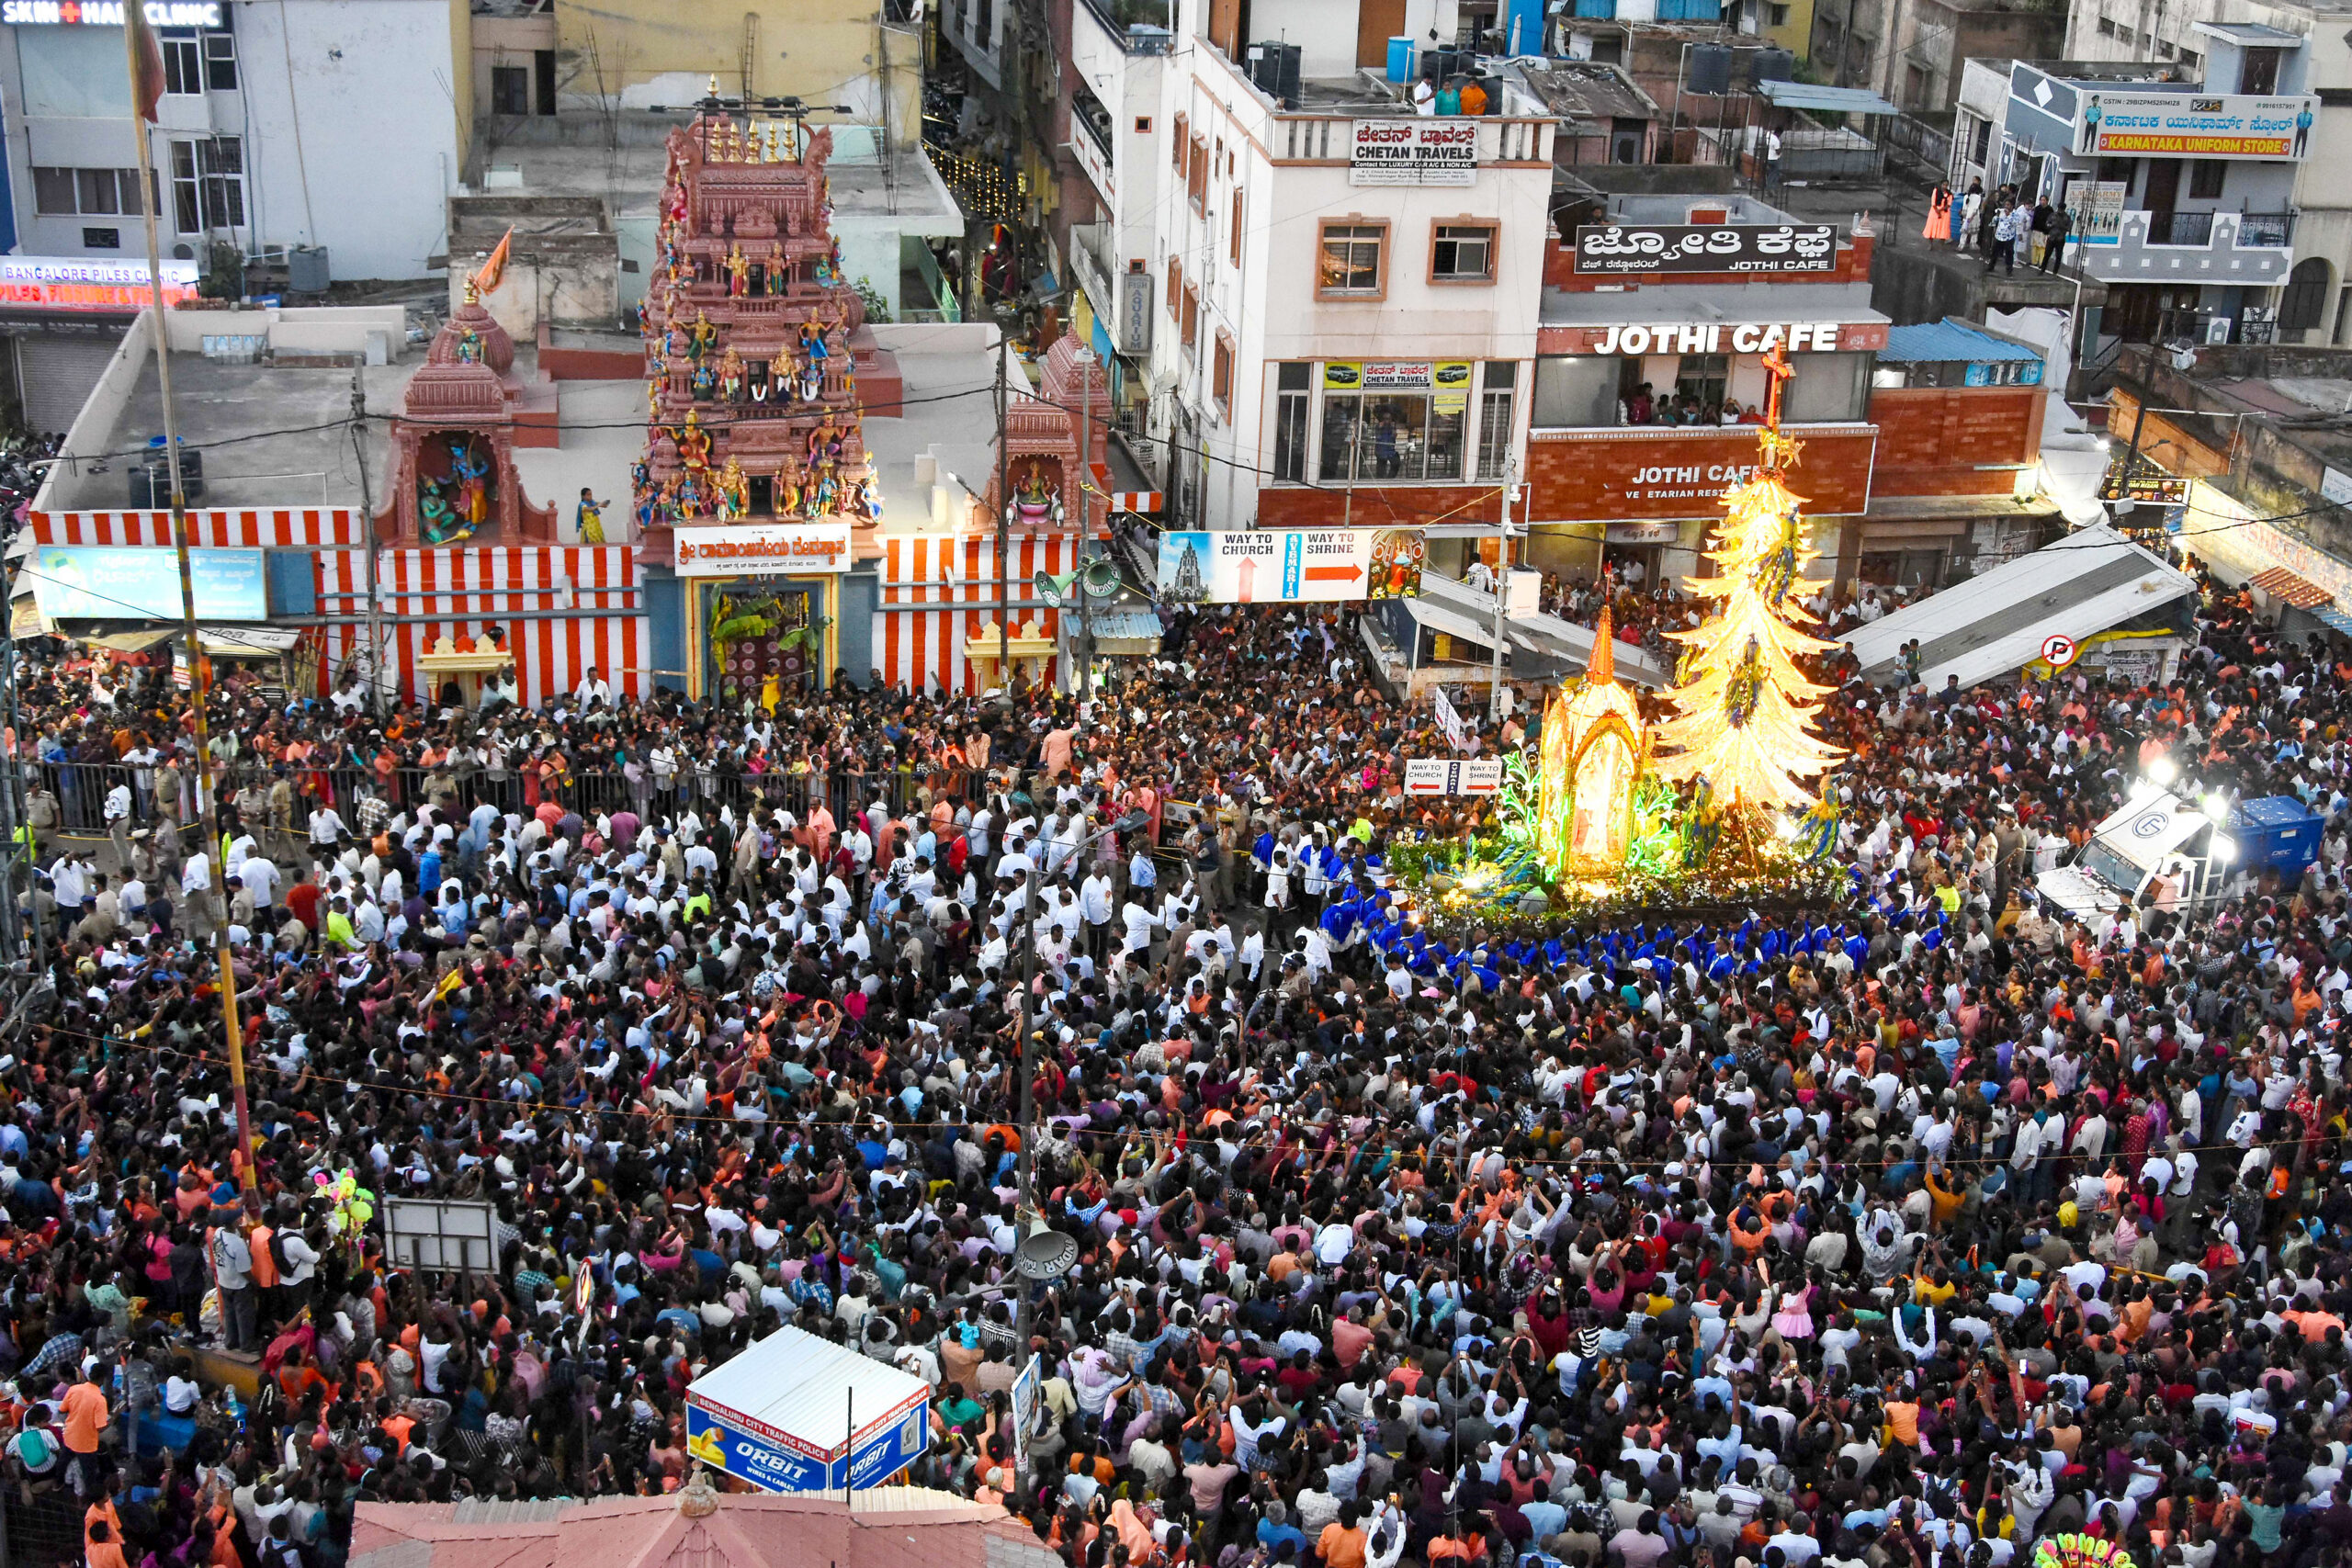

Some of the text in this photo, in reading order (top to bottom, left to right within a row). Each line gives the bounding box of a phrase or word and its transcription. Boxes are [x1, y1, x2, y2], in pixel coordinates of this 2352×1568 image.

[3, 2, 59, 23] SKIN
[142, 4, 220, 25] CLINIC
[1357, 125, 1412, 142] ಚೇತನ್
[1356, 146, 1473, 160] CHETAN TRAVELS
[2108, 136, 2282, 153] KARNATAKA UNIFORM STORE
[1584, 227, 1742, 260] ಜ್ಯೋತಿ
[6, 266, 89, 282] BANGALORE
[93, 268, 130, 282] PILES
[135, 269, 179, 283] CLNIC
[1729, 260, 1828, 270] JOTHI CAFE
[49, 285, 115, 304] FISSURE
[1593, 323, 1838, 355] JOTHI CAFE
[1632, 466, 1700, 484] JOTHI
[1225, 535, 1272, 544] WAY TO
[1308, 533, 1354, 543] WAY TO
[679, 539, 695, 565] ಶ್ರೀ
[1222, 546, 1273, 555] CHURCH
[1306, 544, 1354, 554] SHRINE
[1286, 535, 1299, 598] AVEMARIA
[874, 1416, 888, 1429] CITY
[888, 1402, 910, 1420] TRAFFIC
[909, 1388, 927, 1405] POLICE
[699, 1397, 826, 1460] BENGALURU CITY TRAFFIC POLICE
[736, 1441, 809, 1479] ORBIT
[842, 1438, 892, 1483] ORBIT
[747, 1466, 766, 1479] WIRES
[772, 1477, 795, 1491] CABLES
